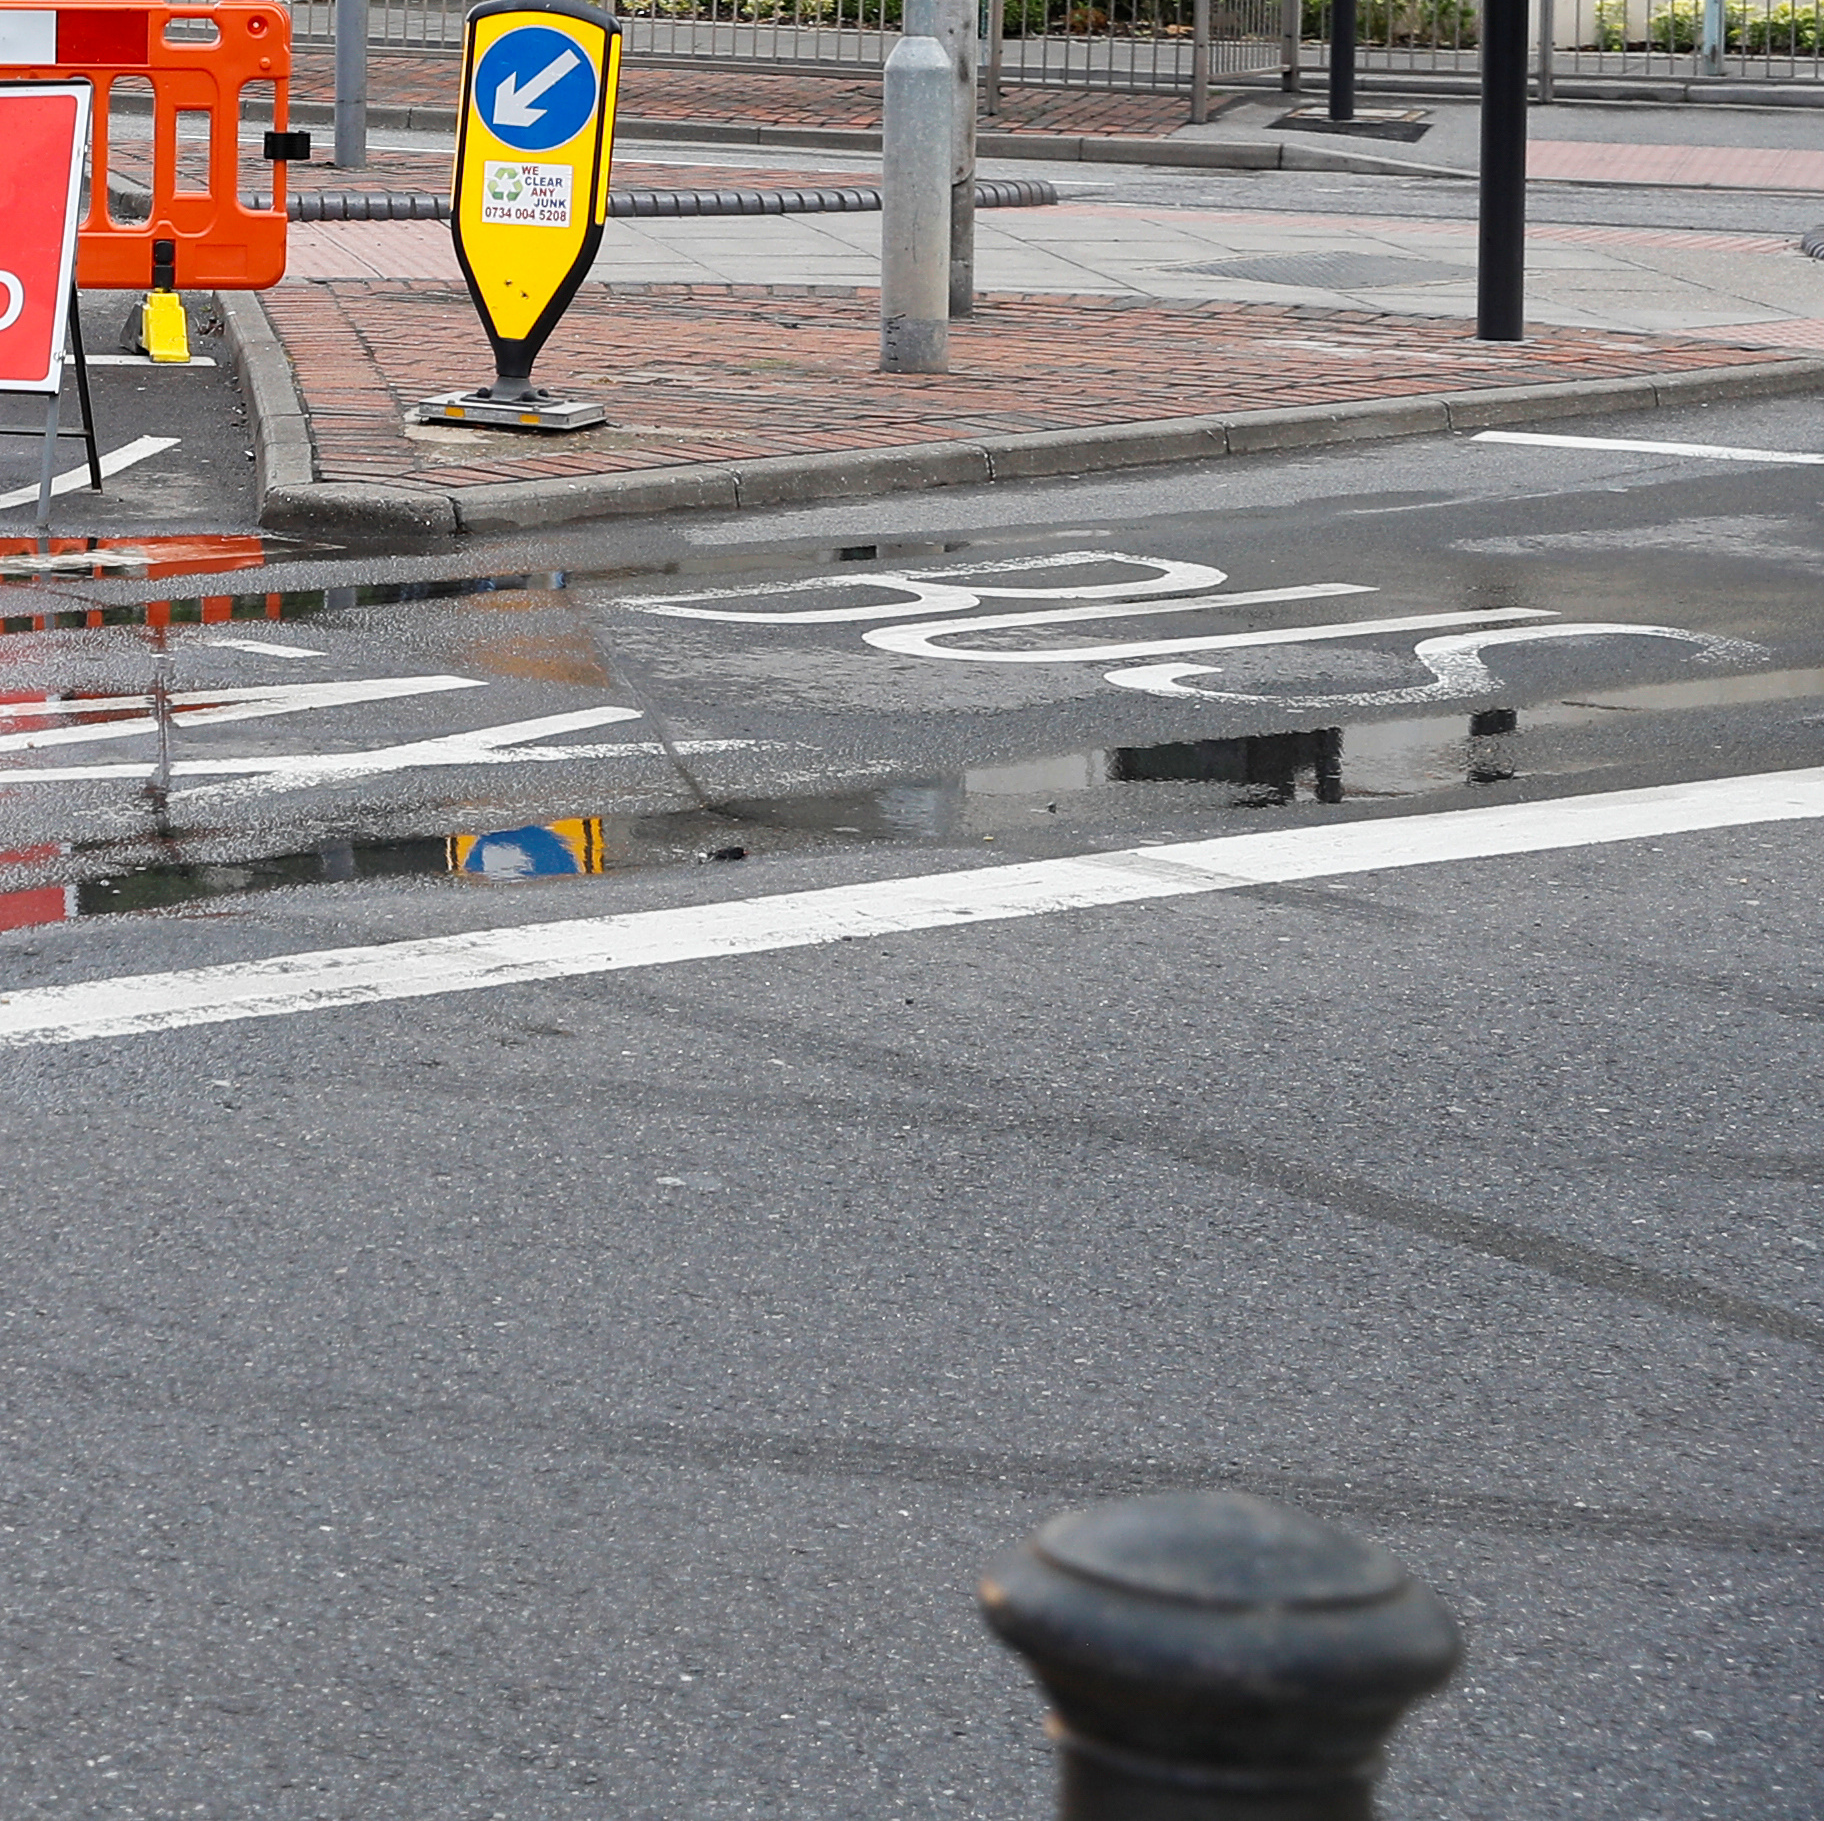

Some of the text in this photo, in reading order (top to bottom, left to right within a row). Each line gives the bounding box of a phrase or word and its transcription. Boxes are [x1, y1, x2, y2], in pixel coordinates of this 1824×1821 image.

[522, 166, 539, 175] WE
[525, 176, 563, 187] CLEAR
[530, 187, 555, 197] ANY
[533, 198, 566, 208] JUNK
[485, 206, 566, 222] 0734 004 5208
[610, 548, 1774, 710] BUS
